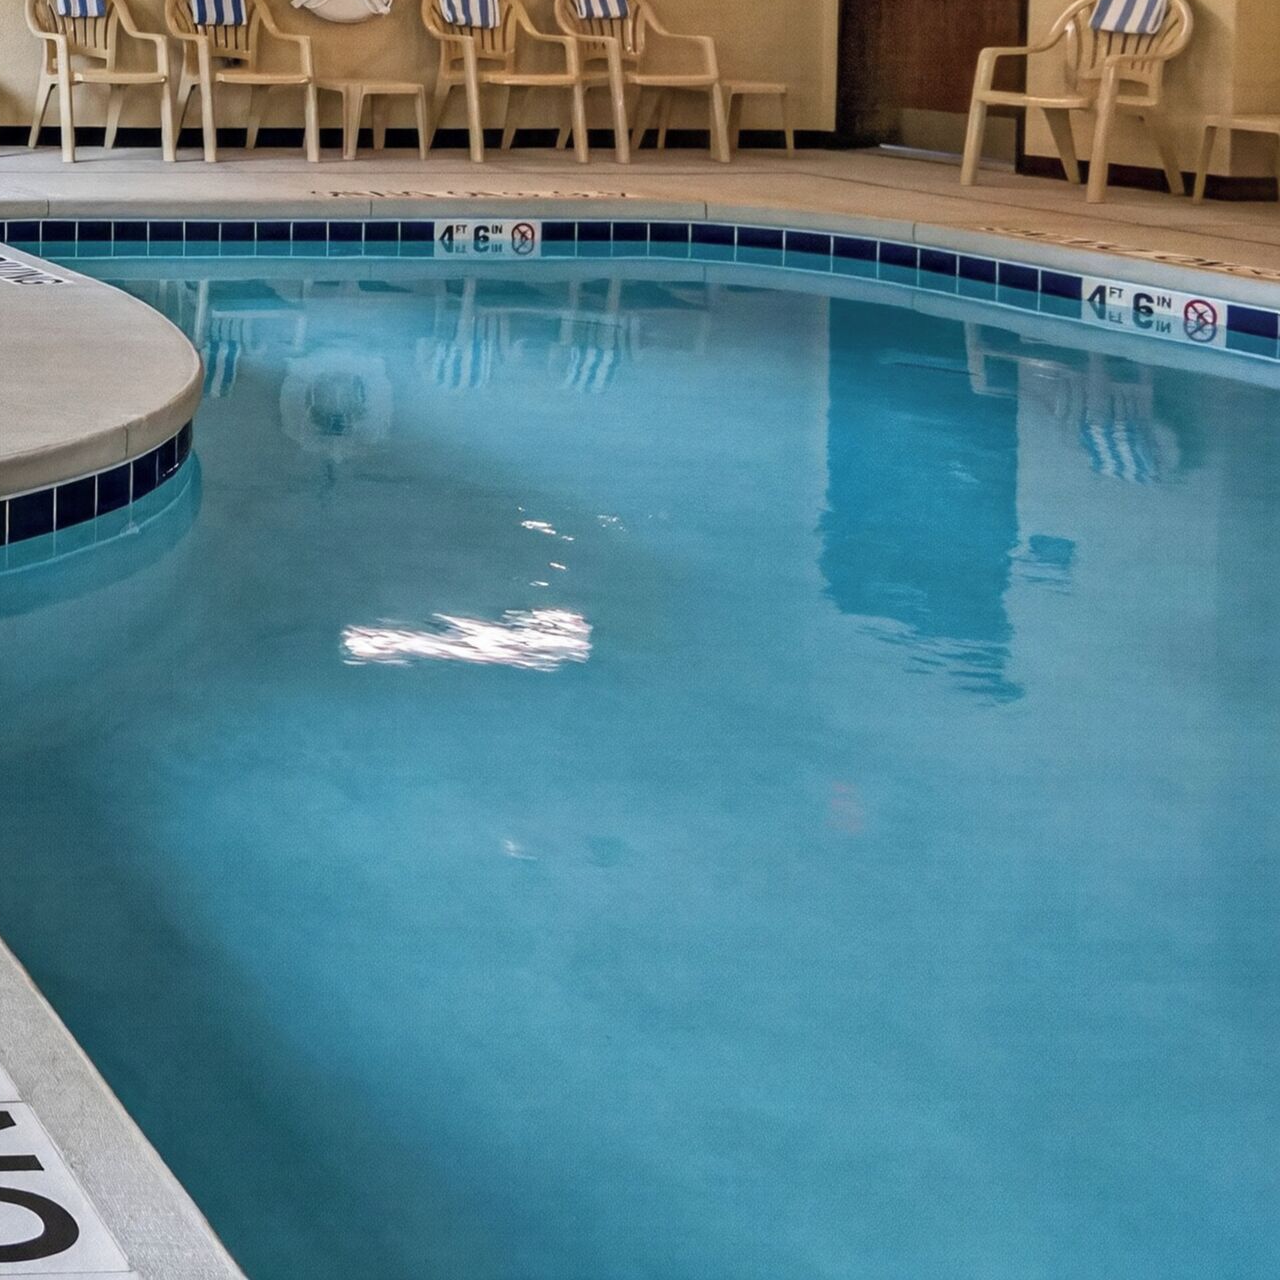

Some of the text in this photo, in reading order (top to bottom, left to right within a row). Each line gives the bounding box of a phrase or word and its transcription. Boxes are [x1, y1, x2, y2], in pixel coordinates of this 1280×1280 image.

[455, 224, 467, 234] FT
[492, 224, 502, 234] IN
[1109, 287, 1123, 298] FT
[1133, 293, 1154, 316] 6
[1157, 296, 1171, 309] IN
